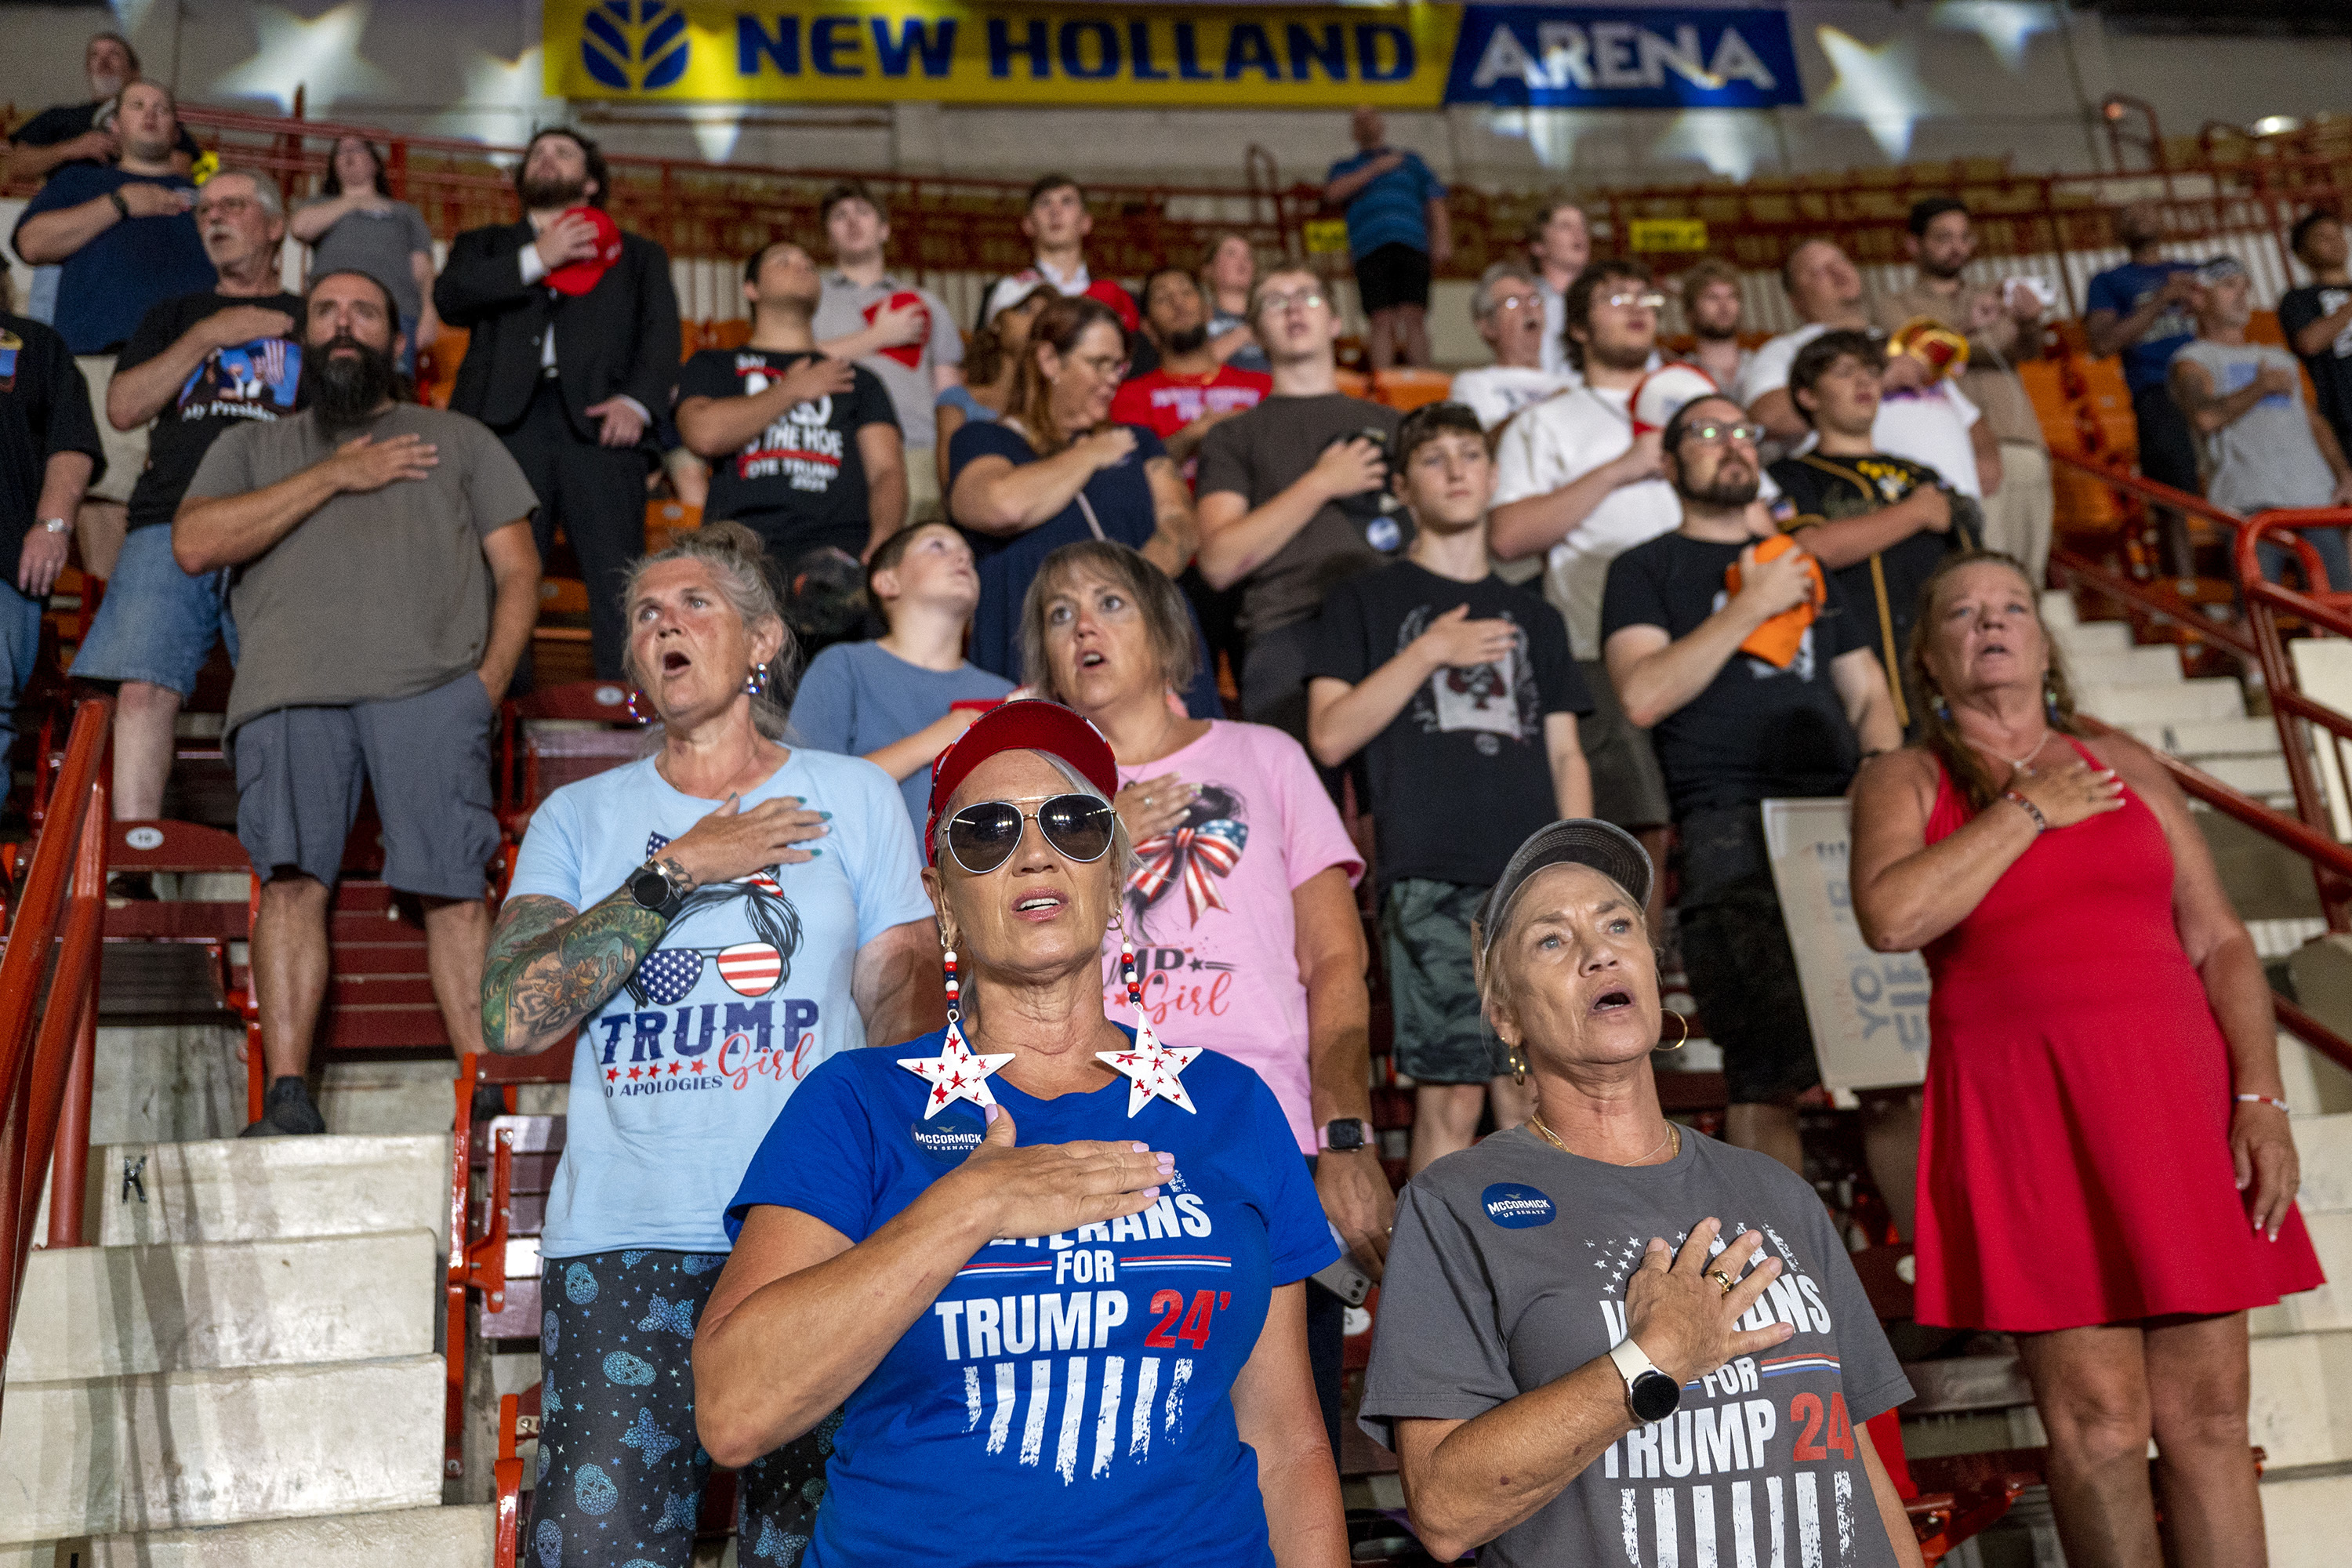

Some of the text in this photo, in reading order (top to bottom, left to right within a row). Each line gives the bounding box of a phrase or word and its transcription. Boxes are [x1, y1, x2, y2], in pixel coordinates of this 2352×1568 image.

[735, 14, 1778, 89] NEW HOLLAND ARENA
[1139, 970, 1232, 1025] Girl
[601, 998, 819, 1065] TRUMP
[619, 1075, 724, 1097] APOLOGIES
[718, 1033, 815, 1091] Girl
[122, 1156, 147, 1204] K
[1055, 1249, 1116, 1285] FOR
[935, 1290, 1129, 1361] TRUMP
[1702, 1356, 1759, 1399] FOR
[1790, 1392, 1855, 1461] 24
